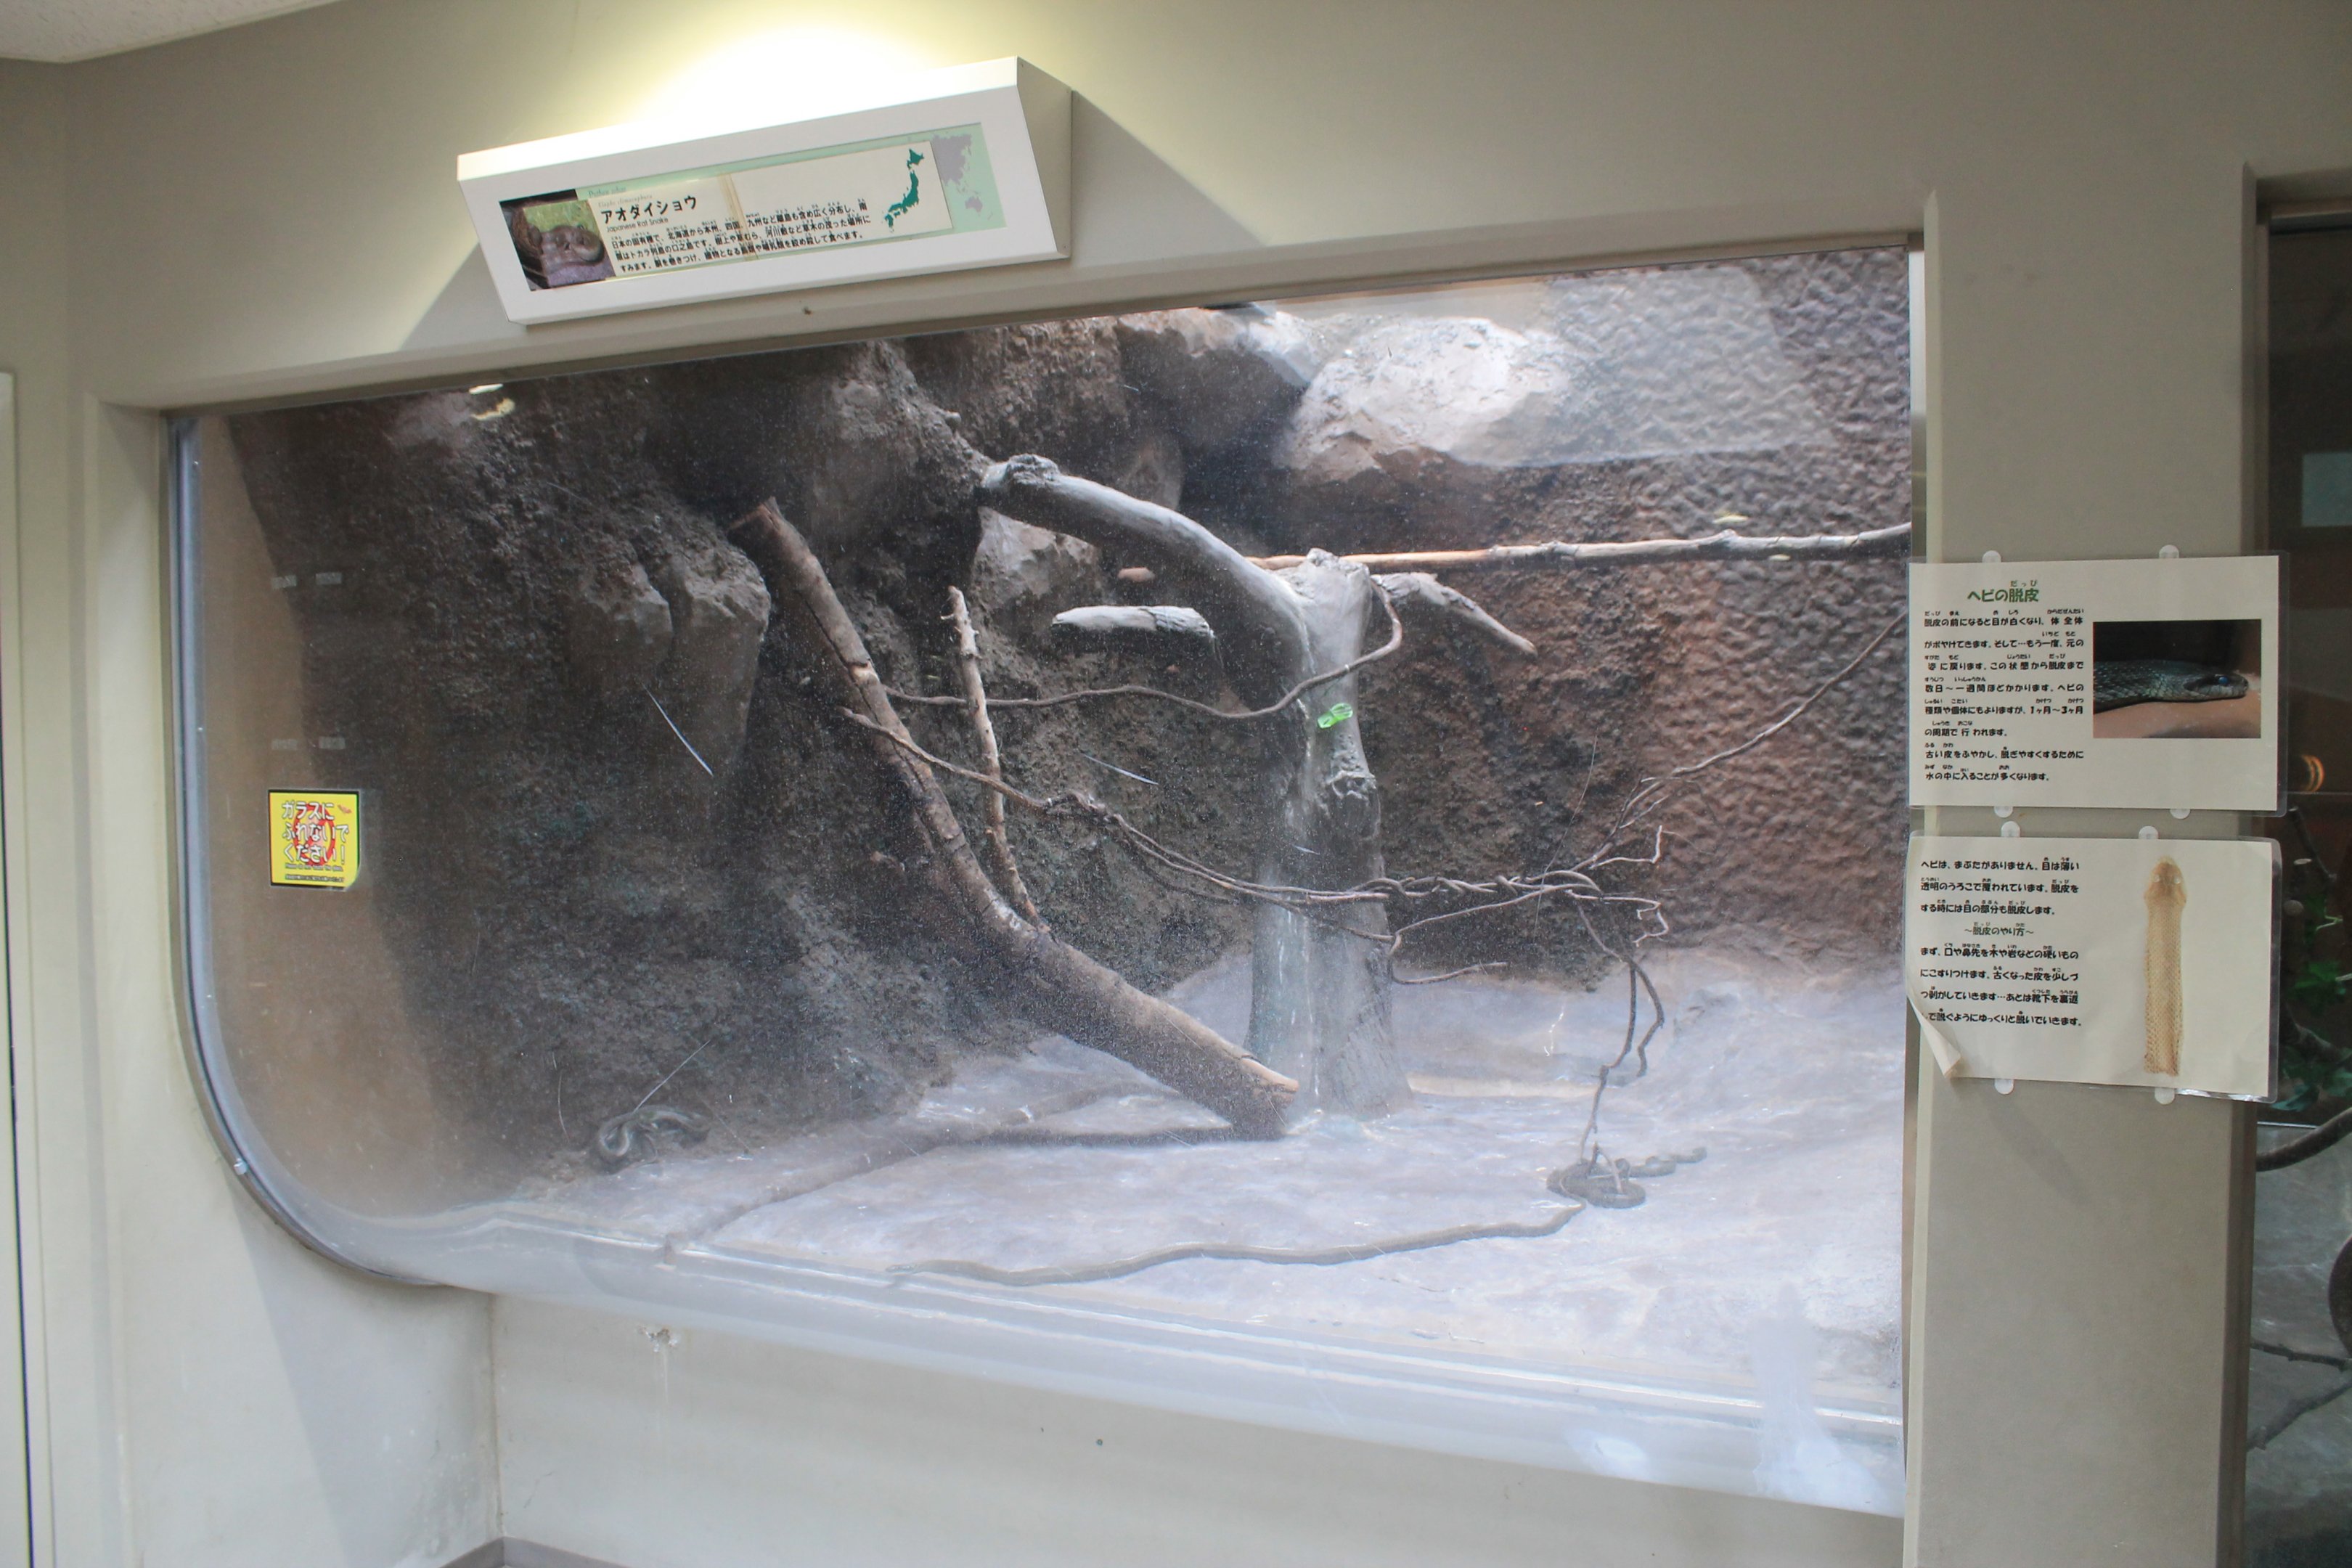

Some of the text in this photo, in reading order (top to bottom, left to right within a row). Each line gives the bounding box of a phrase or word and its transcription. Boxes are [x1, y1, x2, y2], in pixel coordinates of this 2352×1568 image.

[601, 195, 697, 224] アオダイショウ
[607, 217, 669, 232] Japanese Rat Snake
[1967, 589, 2038, 602] ヘビの脱皮
[1926, 772, 2049, 781] 水の中に入ることが多くなります。
[282, 800, 335, 820] ガラスに
[282, 822, 349, 843] ふれないで
[1921, 861, 2079, 871] ヘビは、まぶたがありません。目は薄い
[1921, 882, 2079, 893] 透明のうろこで覆われています。脱皮を
[1921, 905, 2054, 915] する時には目の部分も脱皮します。
[1921, 947, 2078, 959] まず、口や鼻先を木や岩などの硬いもの
